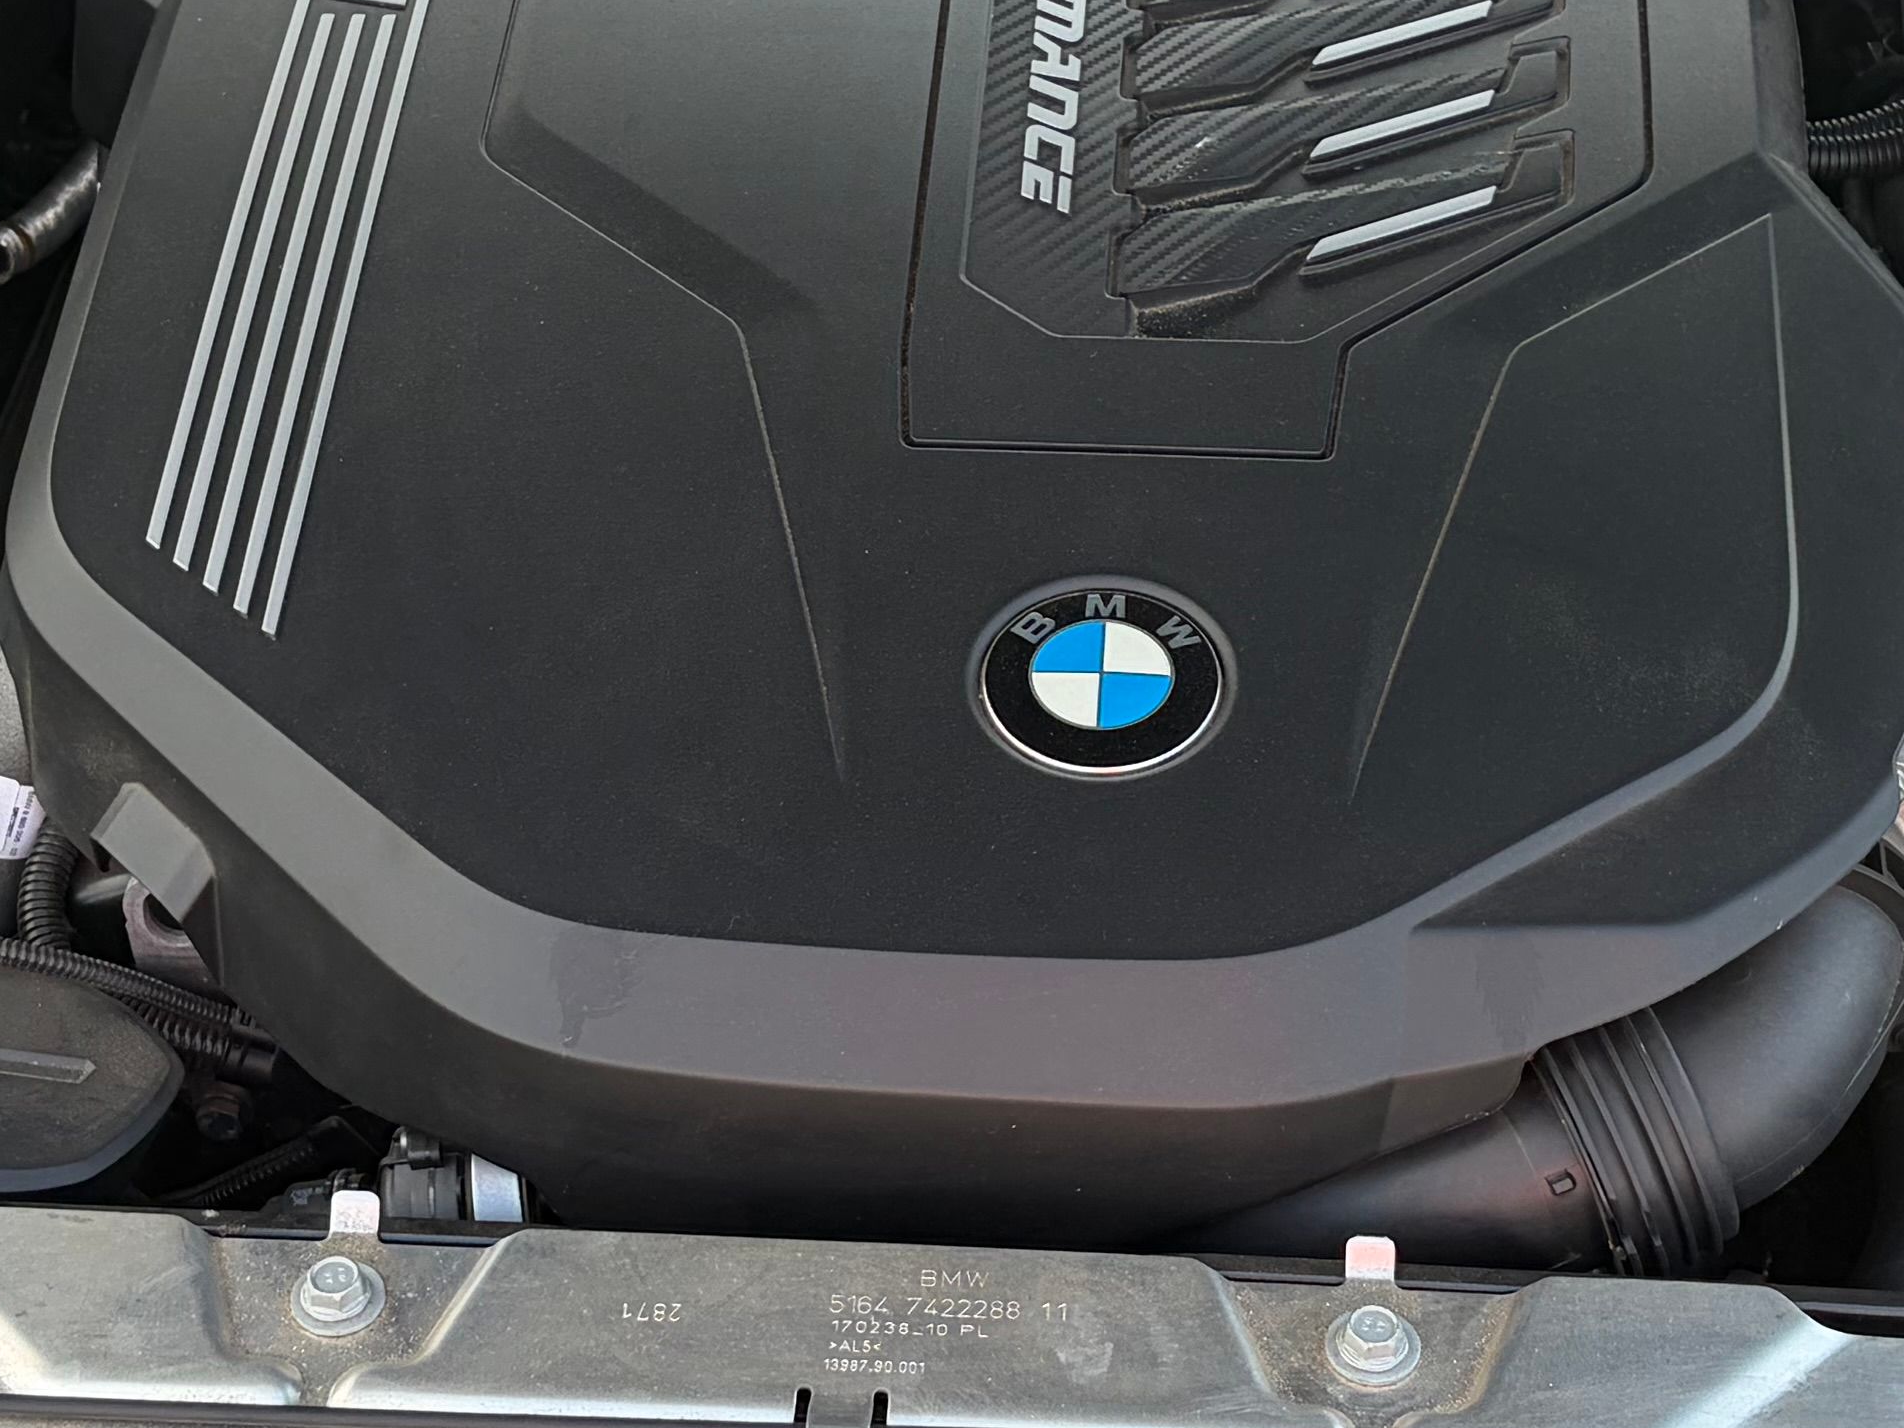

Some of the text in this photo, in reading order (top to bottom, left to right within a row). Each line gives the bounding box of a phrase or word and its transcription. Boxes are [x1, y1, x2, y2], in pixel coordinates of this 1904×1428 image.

[1010, 594, 1202, 650] BMW
[920, 1269, 990, 1288] BMW
[622, 1302, 682, 1322] 2871
[828, 1294, 1068, 1322] 5164 7422288 11
[959, 1324, 989, 1338] PL
